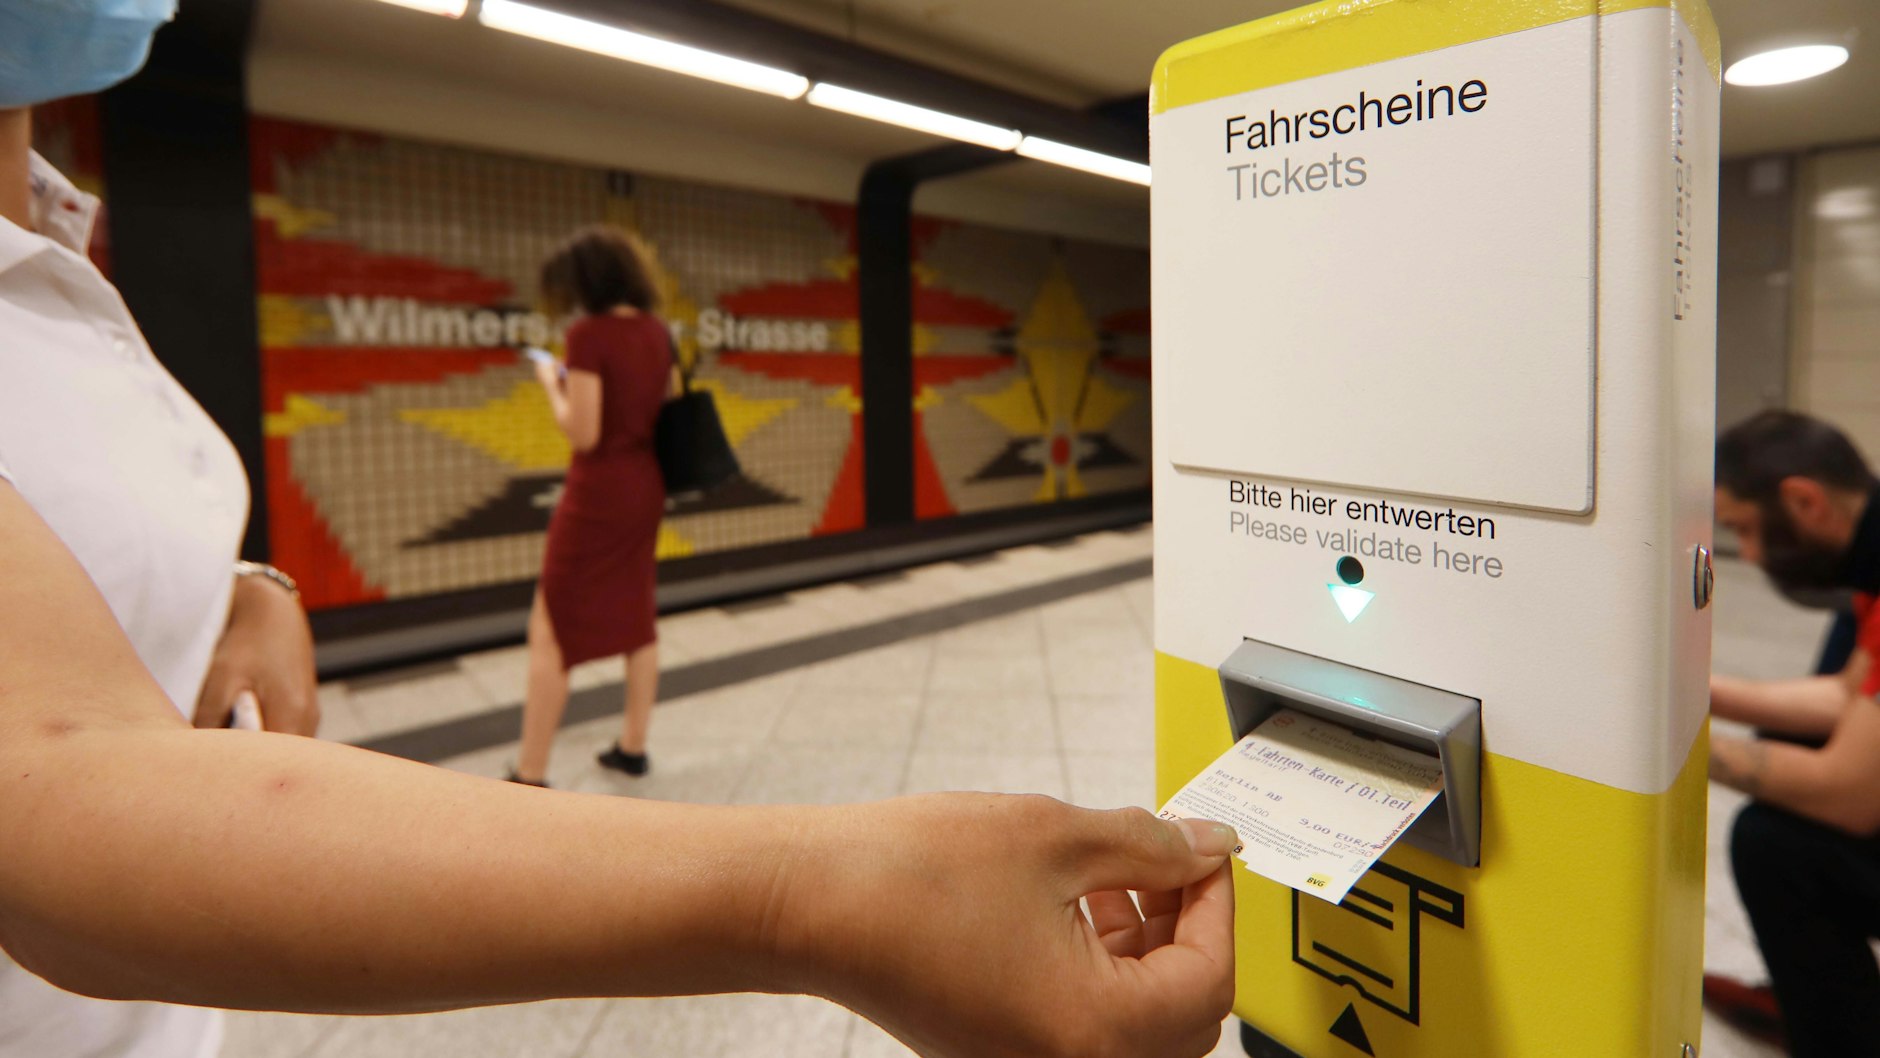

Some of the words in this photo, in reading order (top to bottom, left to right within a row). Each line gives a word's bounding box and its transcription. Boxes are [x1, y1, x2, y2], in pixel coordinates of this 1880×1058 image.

[1226, 79, 1488, 153] Fahrscheine
[1227, 152, 1367, 201] Tickets
[697, 308, 829, 351] Strasse
[1229, 480, 1282, 509] Bitte
[1291, 487, 1337, 516] hier
[1346, 499, 1495, 539] entwerten
[1230, 511, 1307, 544] Please
[1316, 528, 1422, 565] validate
[1433, 541, 1503, 579] here
[1215, 769, 1258, 791] Berlin
[1266, 792, 1282, 801] AB
[1245, 742, 1344, 786] 4-Fahrten-Karte
[1358, 786, 1412, 810] 01.Teil
[1299, 818, 1330, 834] 9,00
[1306, 877, 1325, 886] BVG
